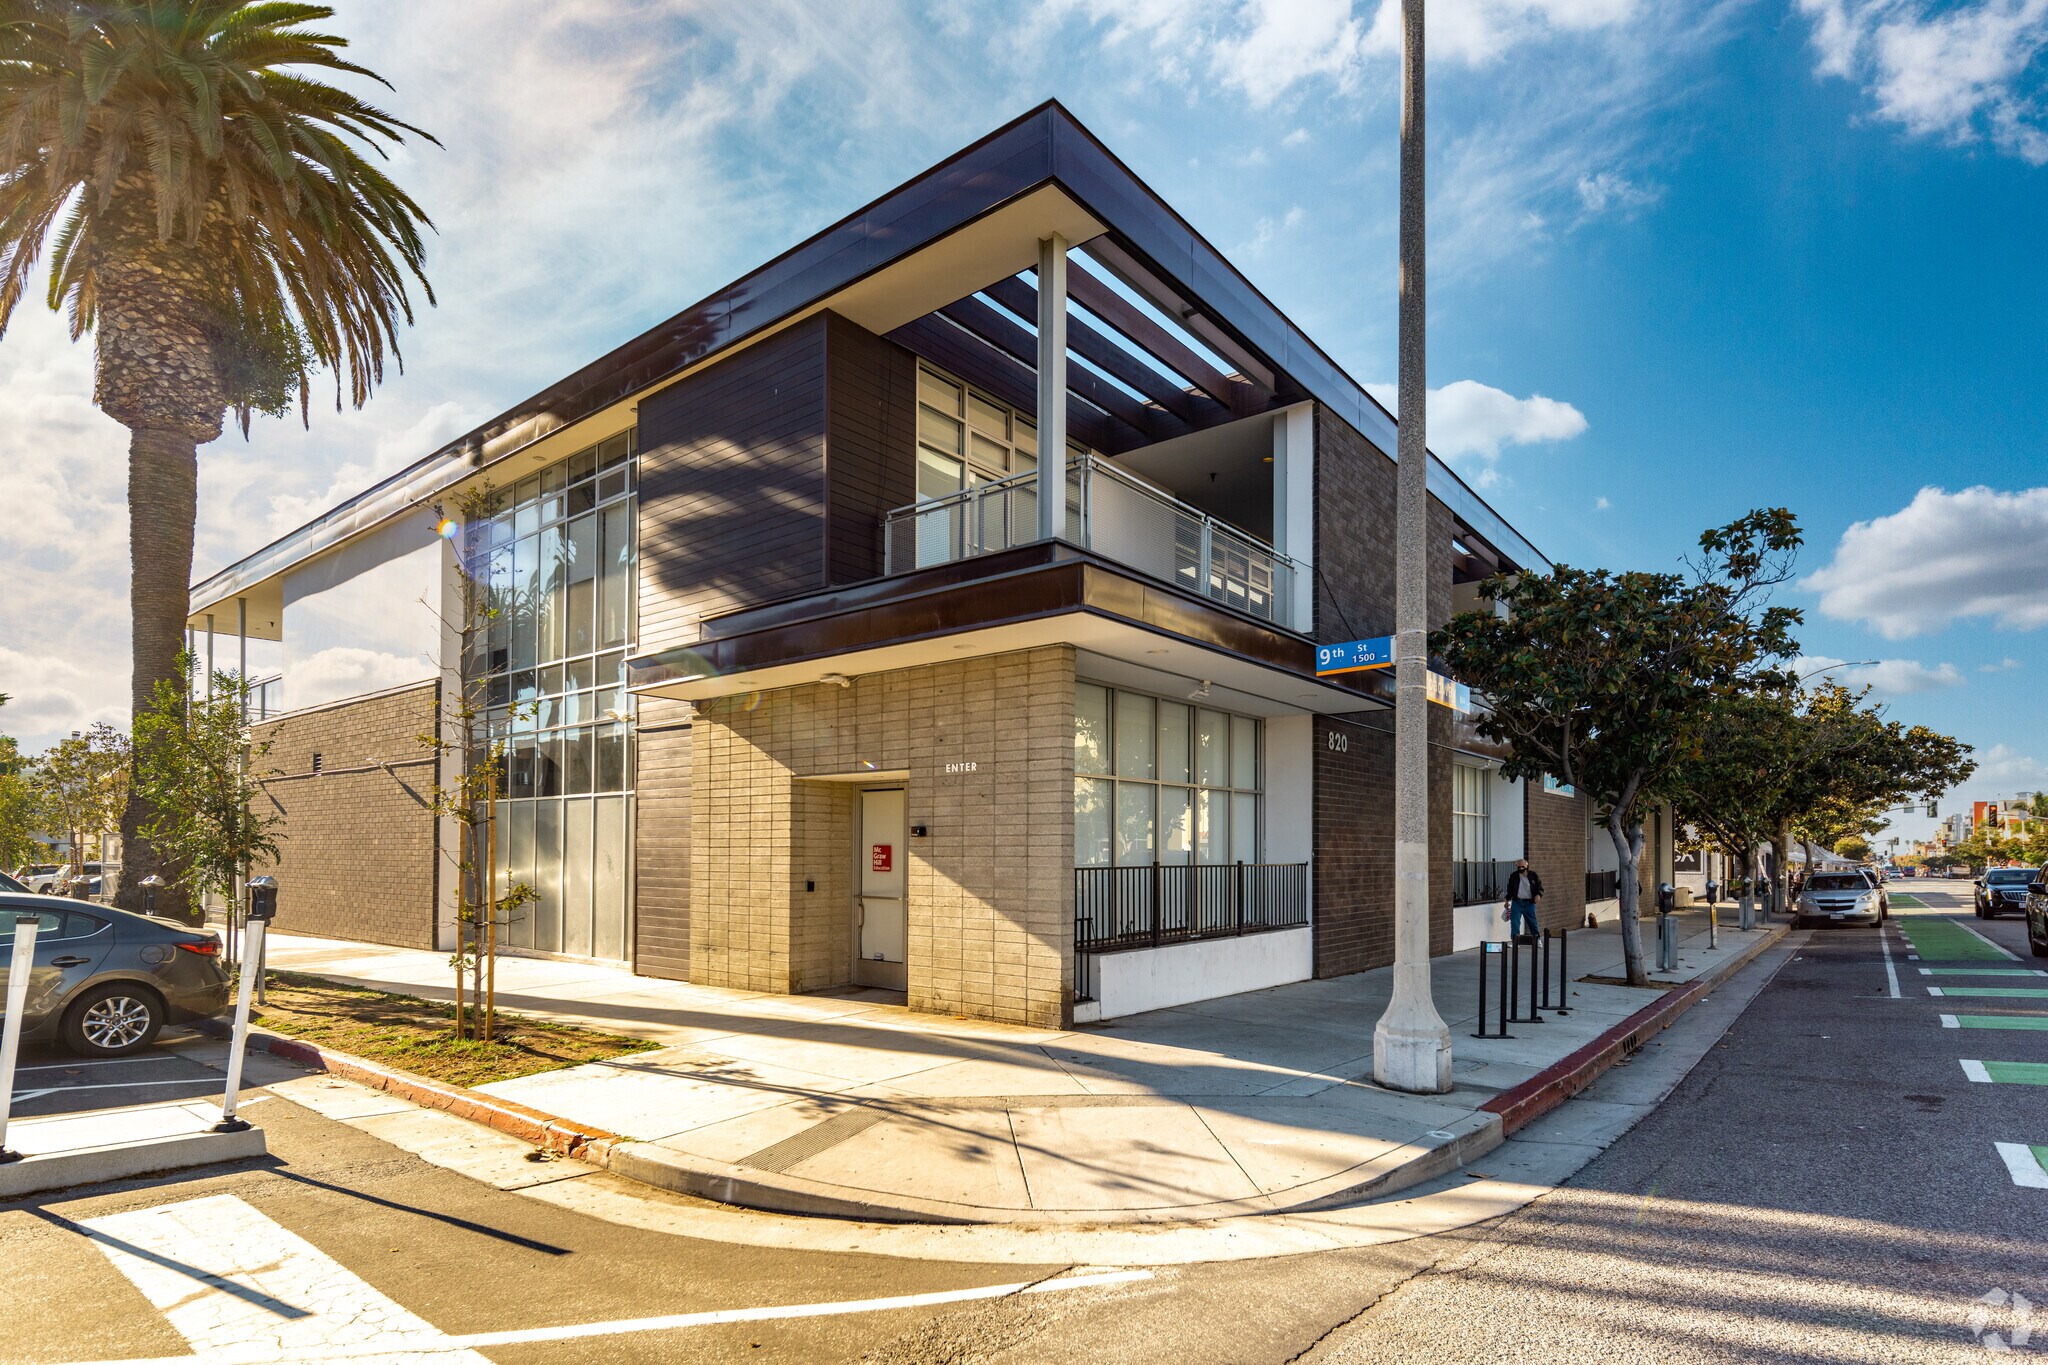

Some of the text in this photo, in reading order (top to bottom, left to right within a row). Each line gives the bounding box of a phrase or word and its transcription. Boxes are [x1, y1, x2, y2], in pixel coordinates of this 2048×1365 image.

[1319, 644, 1367, 665] 9th St
[1352, 652, 1375, 663] 1500
[1328, 731, 1348, 753] 820
[945, 762, 977, 773] ENTER
